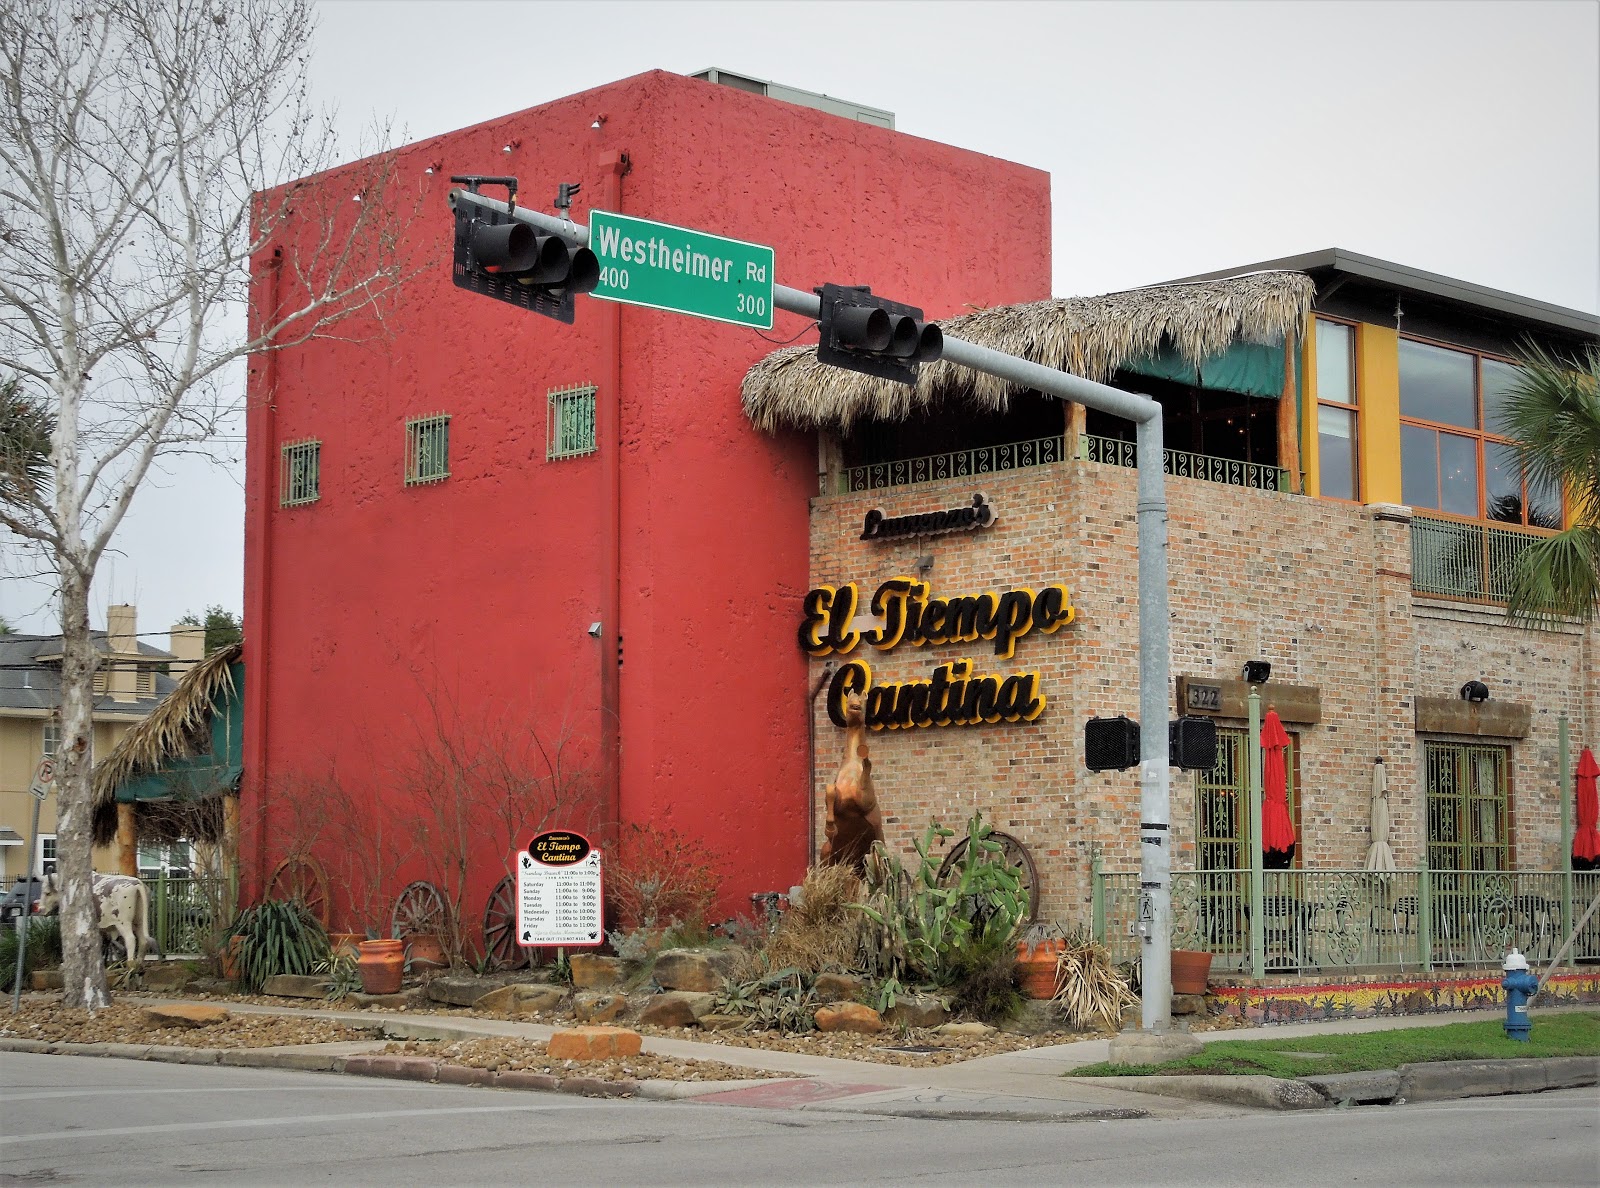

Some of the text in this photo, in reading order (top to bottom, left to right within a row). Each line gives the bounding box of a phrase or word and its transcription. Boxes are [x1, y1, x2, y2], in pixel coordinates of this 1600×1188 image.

[599, 224, 766, 283] Westheimer Rd
[599, 266, 629, 290] 400
[737, 293, 766, 317] 300
[799, 576, 1074, 660] El Tiempo
[827, 658, 1046, 731] Cantina
[1192, 688, 1218, 706] 322
[537, 842, 581, 853] El Tiempo
[542, 853, 576, 862] Cantina
